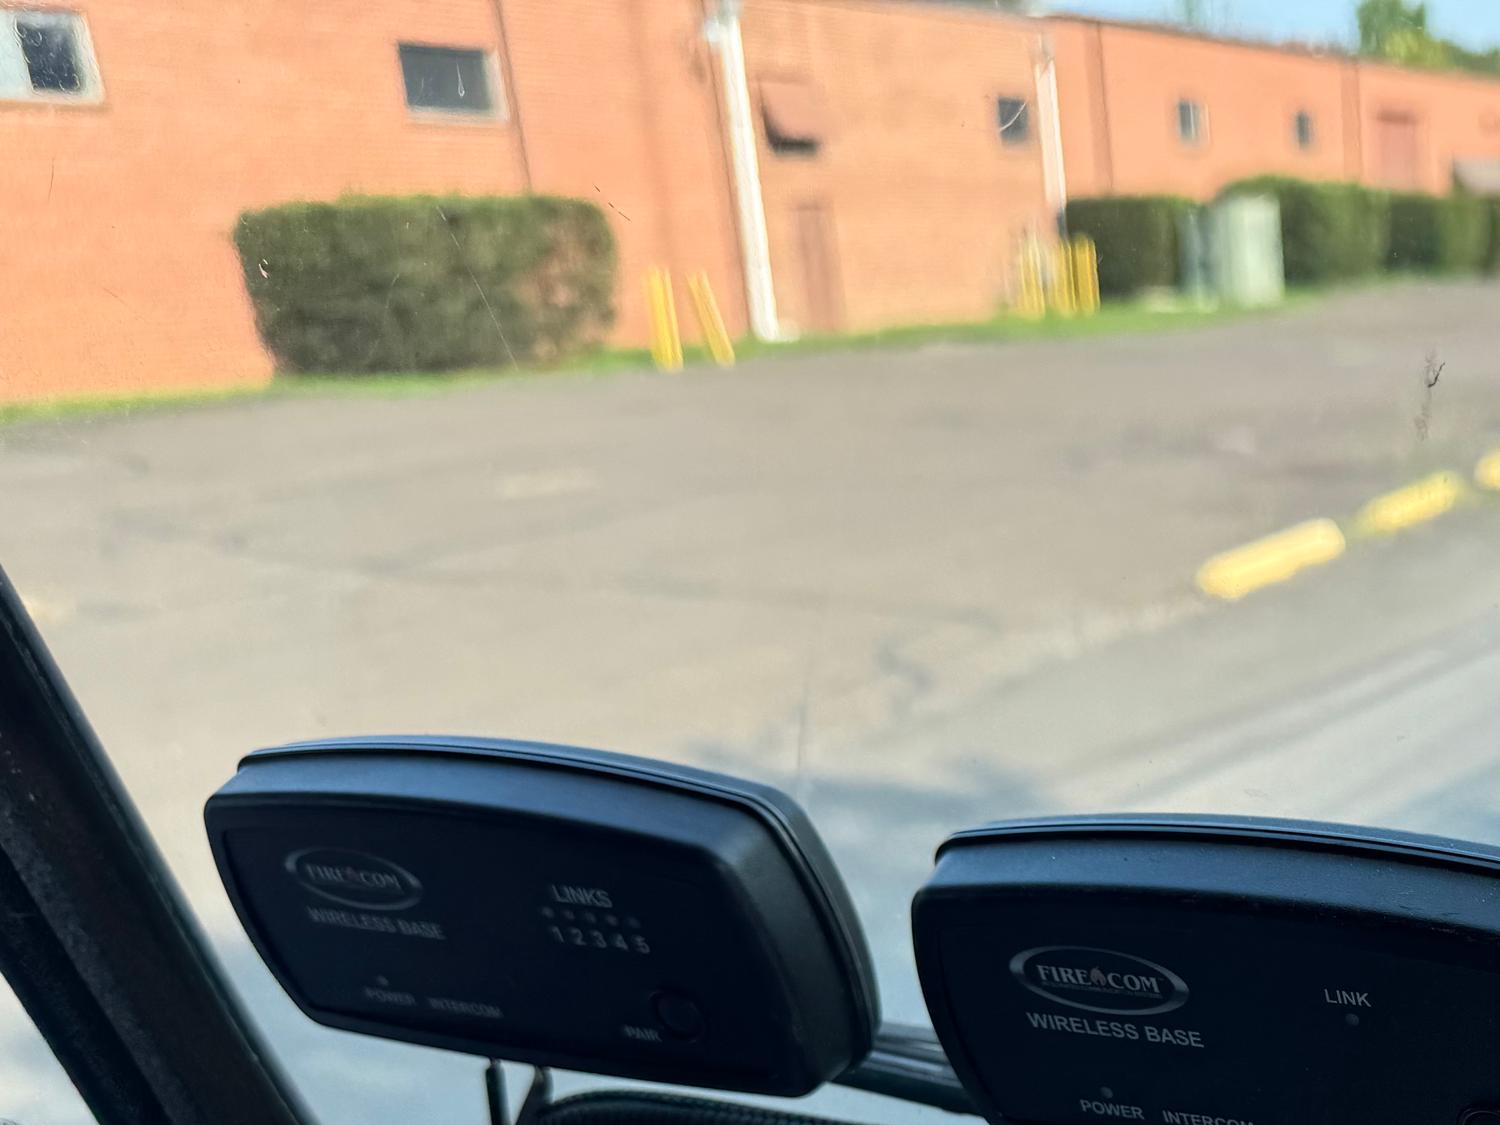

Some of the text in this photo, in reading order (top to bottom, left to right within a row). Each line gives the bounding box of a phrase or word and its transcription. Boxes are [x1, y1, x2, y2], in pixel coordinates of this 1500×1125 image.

[551, 884, 613, 908] LINKS
[306, 905, 447, 940] WIRELESS BASE
[552, 926, 650, 954] 1 2 3 4 5
[364, 987, 503, 1018] POWER INTERCOM
[1324, 988, 1371, 1008] LINK
[1026, 1012, 1204, 1048] WIRELESS BASE
[1080, 1099, 1145, 1120] POWER
